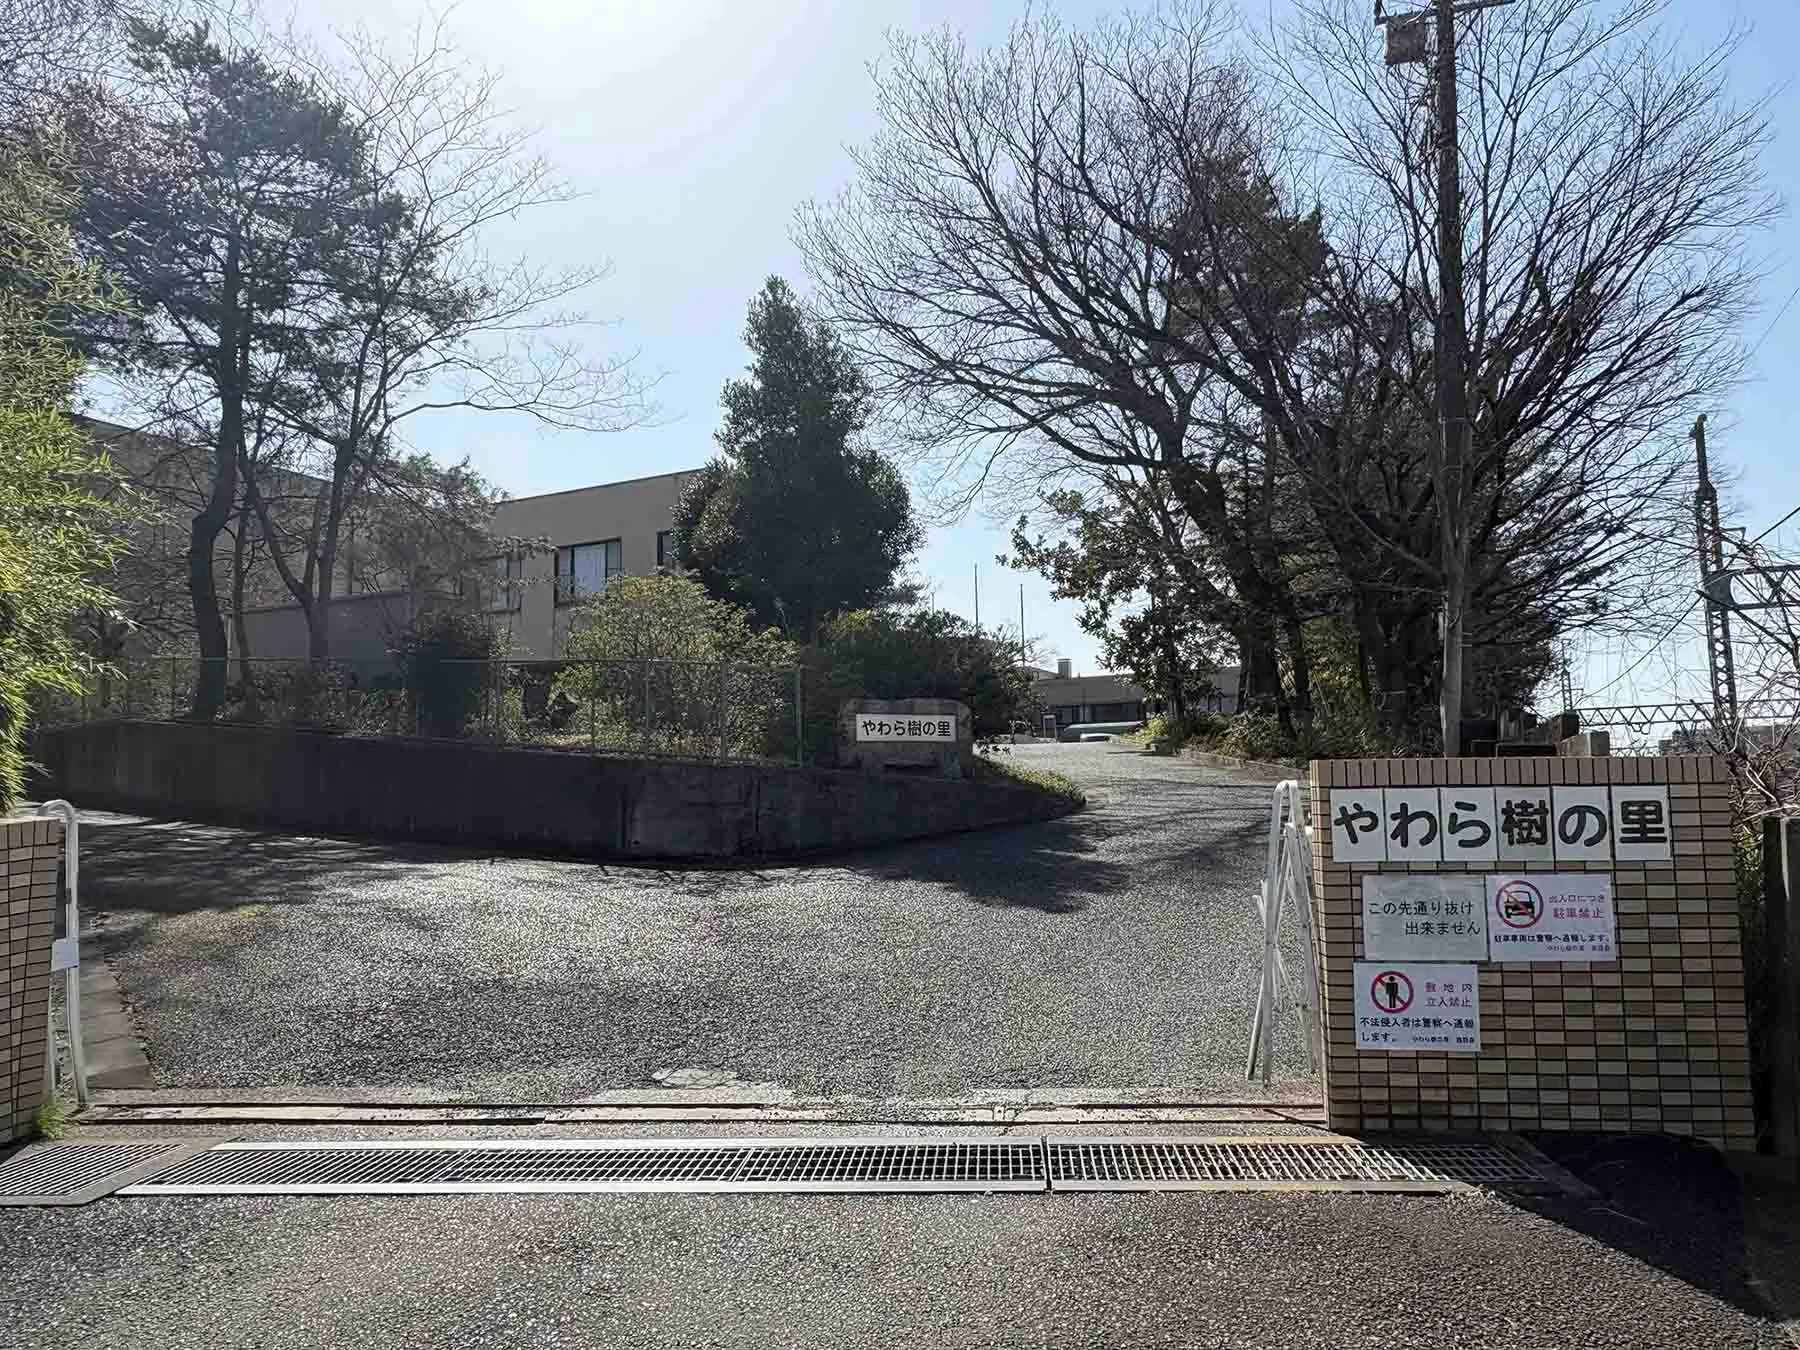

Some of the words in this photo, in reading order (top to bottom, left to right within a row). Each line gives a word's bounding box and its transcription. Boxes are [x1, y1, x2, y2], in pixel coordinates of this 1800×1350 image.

[862, 720, 951, 737] やわら樹の里
[1333, 799, 1668, 848] やわら樹の里
[1368, 901, 1474, 916] この先通り抜け
[1553, 907, 1605, 919] 駐車禁止
[1405, 920, 1481, 936] 出来ません
[1425, 996, 1473, 1008] 立入禁止
[1359, 1016, 1475, 1029] 不法侵入者は警察へ通報
